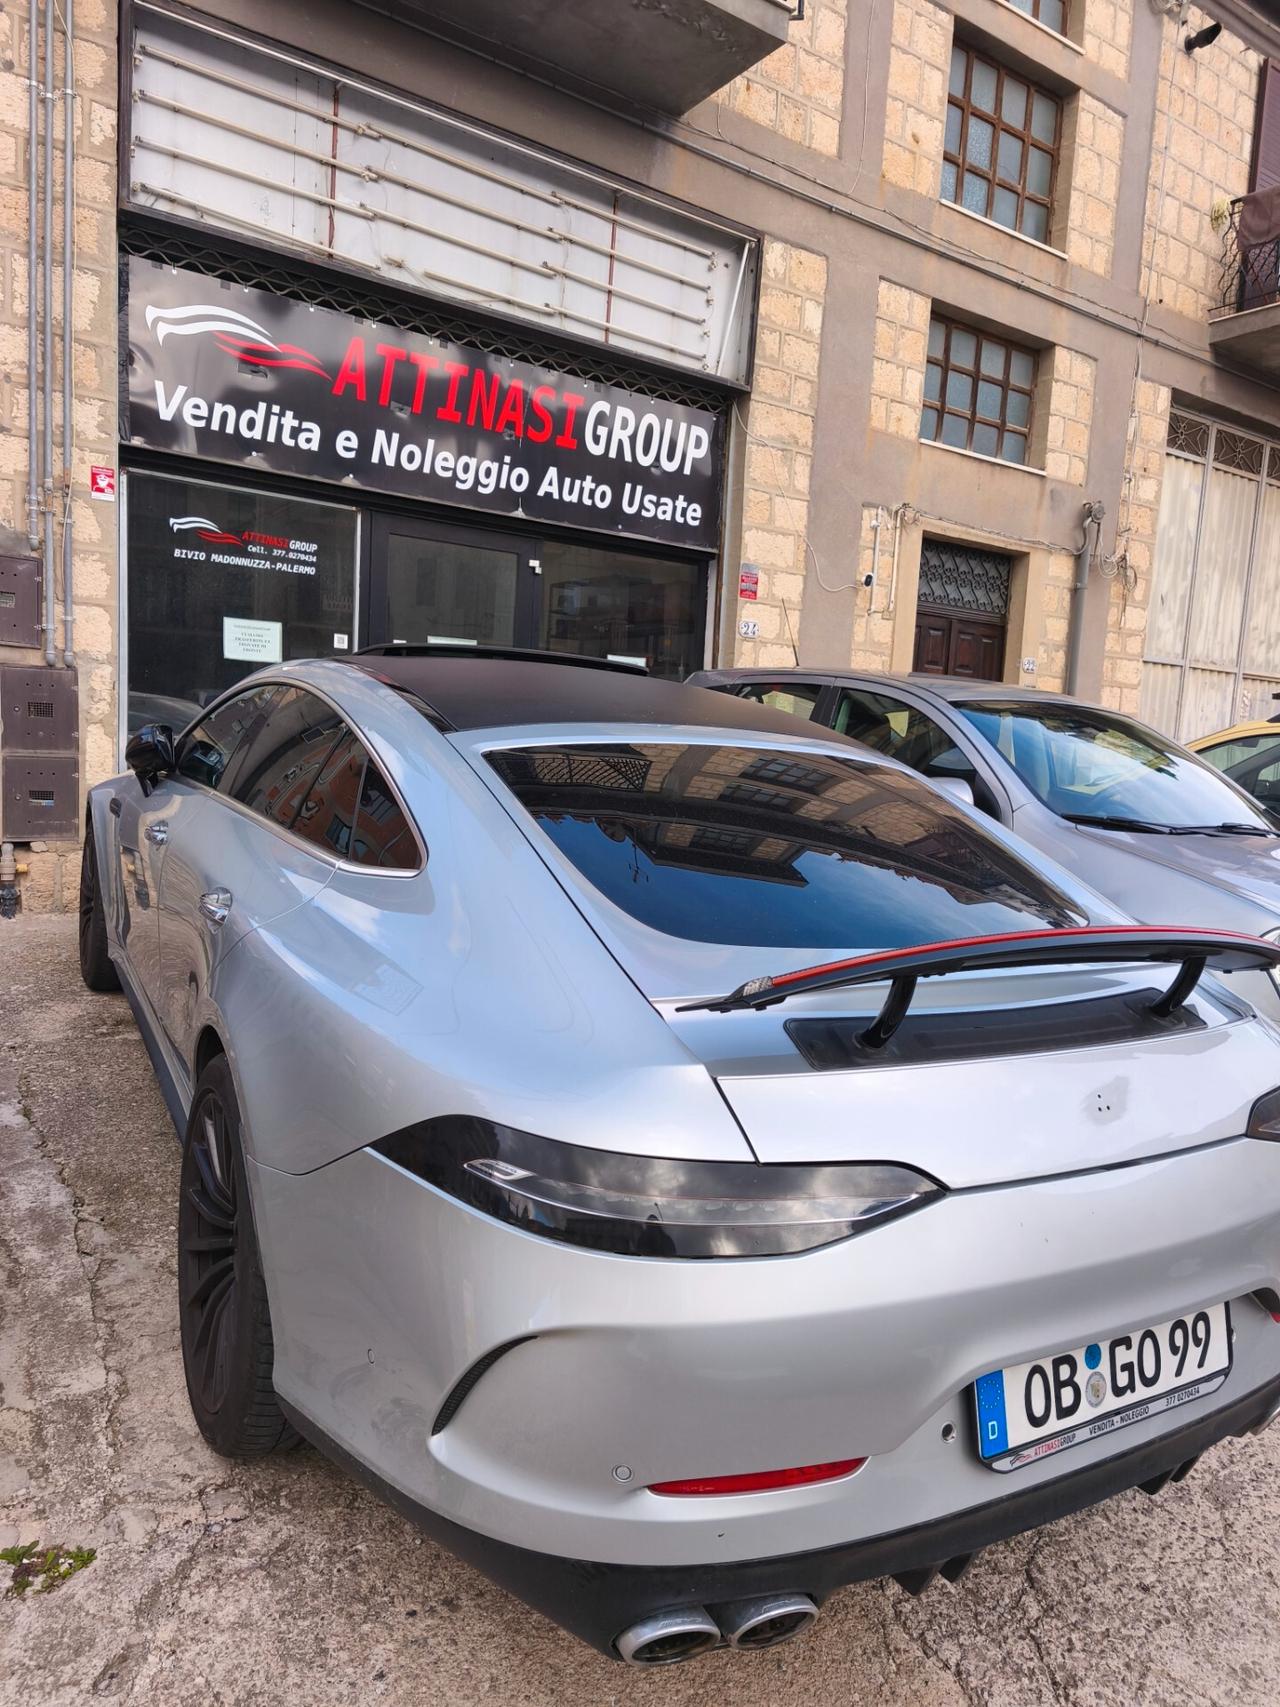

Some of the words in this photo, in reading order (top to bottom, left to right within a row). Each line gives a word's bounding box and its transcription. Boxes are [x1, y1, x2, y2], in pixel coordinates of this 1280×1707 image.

[154, 379, 321, 452] Vendita
[335, 429, 359, 459] e
[371, 428, 530, 495] Noleggio
[537, 466, 612, 509] Auto
[621, 482, 702, 526] Usate
[173, 548, 206, 561] BIVIO
[247, 544, 268, 555] Cell.
[271, 548, 317, 563] 377.0270434
[1024, 1353, 1082, 1429] OB
[1089, 1419, 1115, 1435] VENDITA
[1120, 1406, 1150, 1424] NOLEGGIO
[1165, 1395, 1176, 1407] 377
[1177, 1386, 1200, 1403] 0270434
[988, 1421, 998, 1440] D
